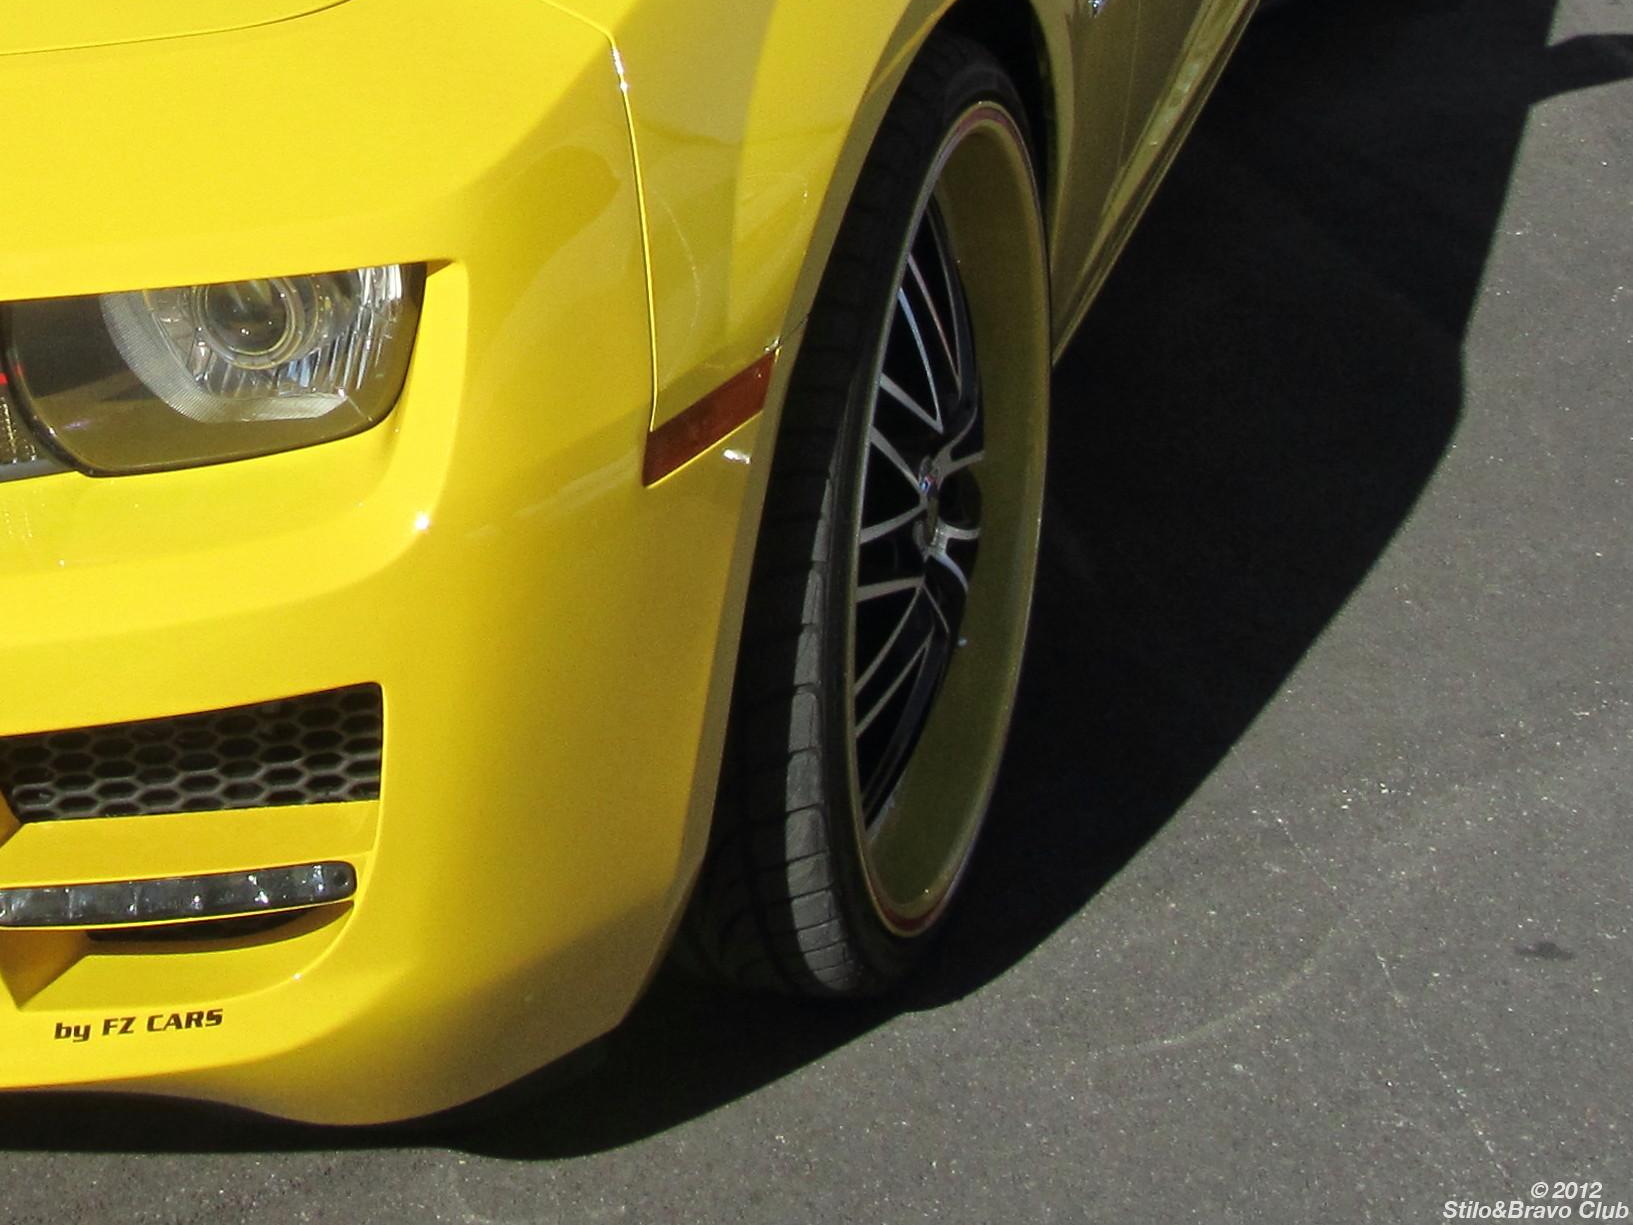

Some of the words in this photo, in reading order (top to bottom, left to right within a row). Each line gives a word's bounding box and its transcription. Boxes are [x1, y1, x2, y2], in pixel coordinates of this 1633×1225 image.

[54, 1022, 91, 1043] by
[102, 1016, 136, 1036] FZ
[146, 1008, 224, 1032] CARS
